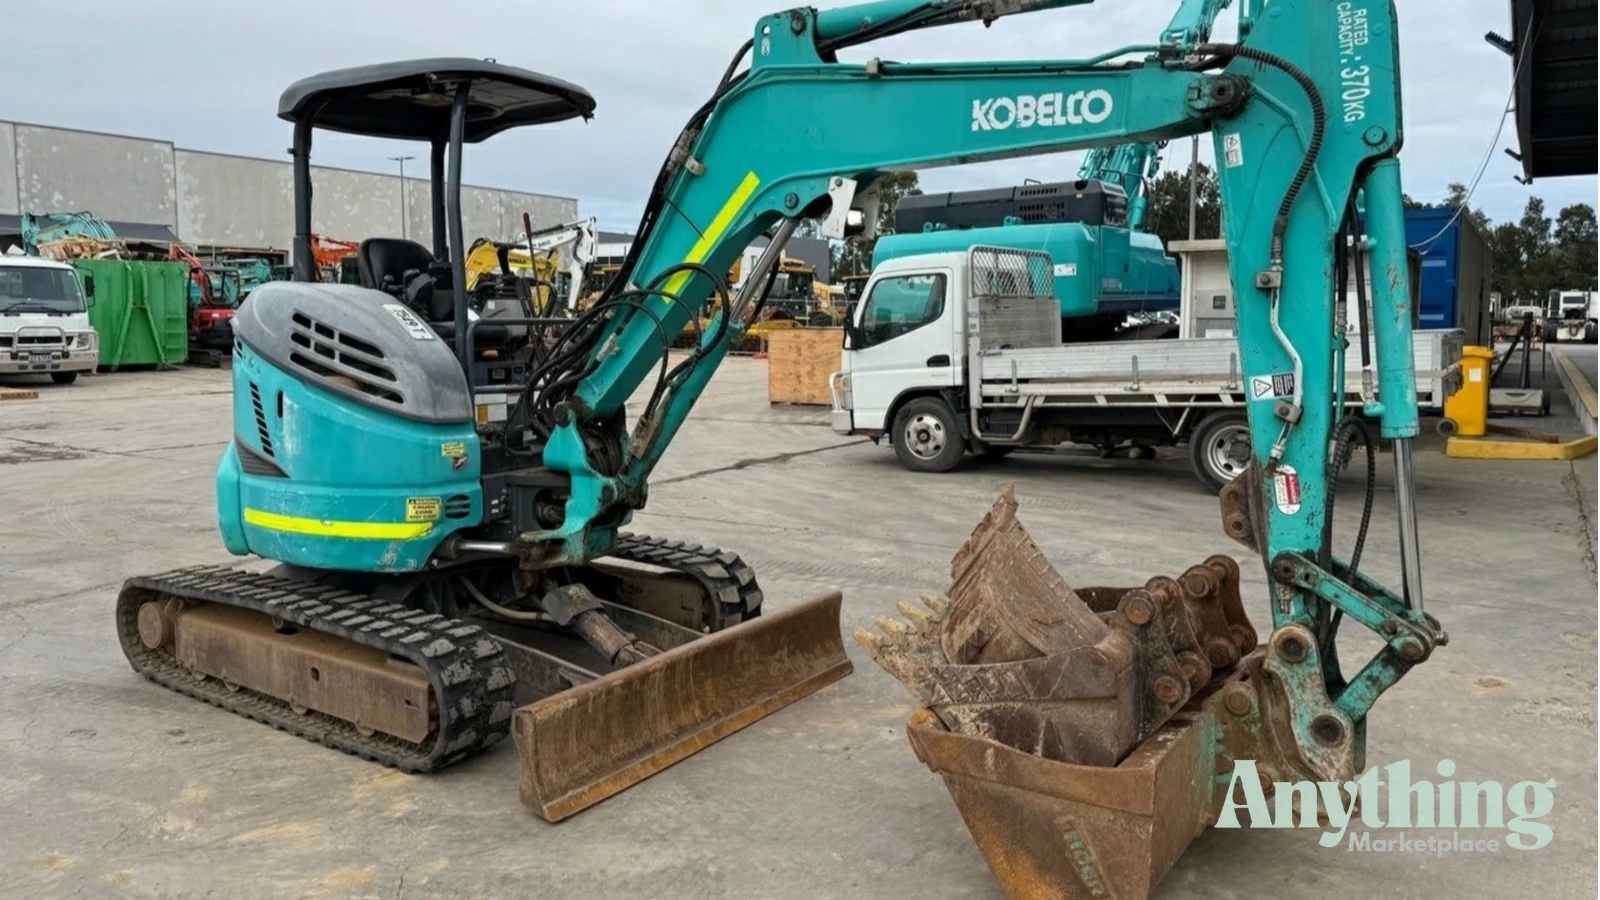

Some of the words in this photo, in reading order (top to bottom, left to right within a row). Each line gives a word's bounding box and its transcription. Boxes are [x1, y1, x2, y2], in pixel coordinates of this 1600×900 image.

[1337, 2, 1354, 55] CAPACITY
[1353, 8, 1369, 46] RATED
[971, 89, 1113, 132] KOBELCO
